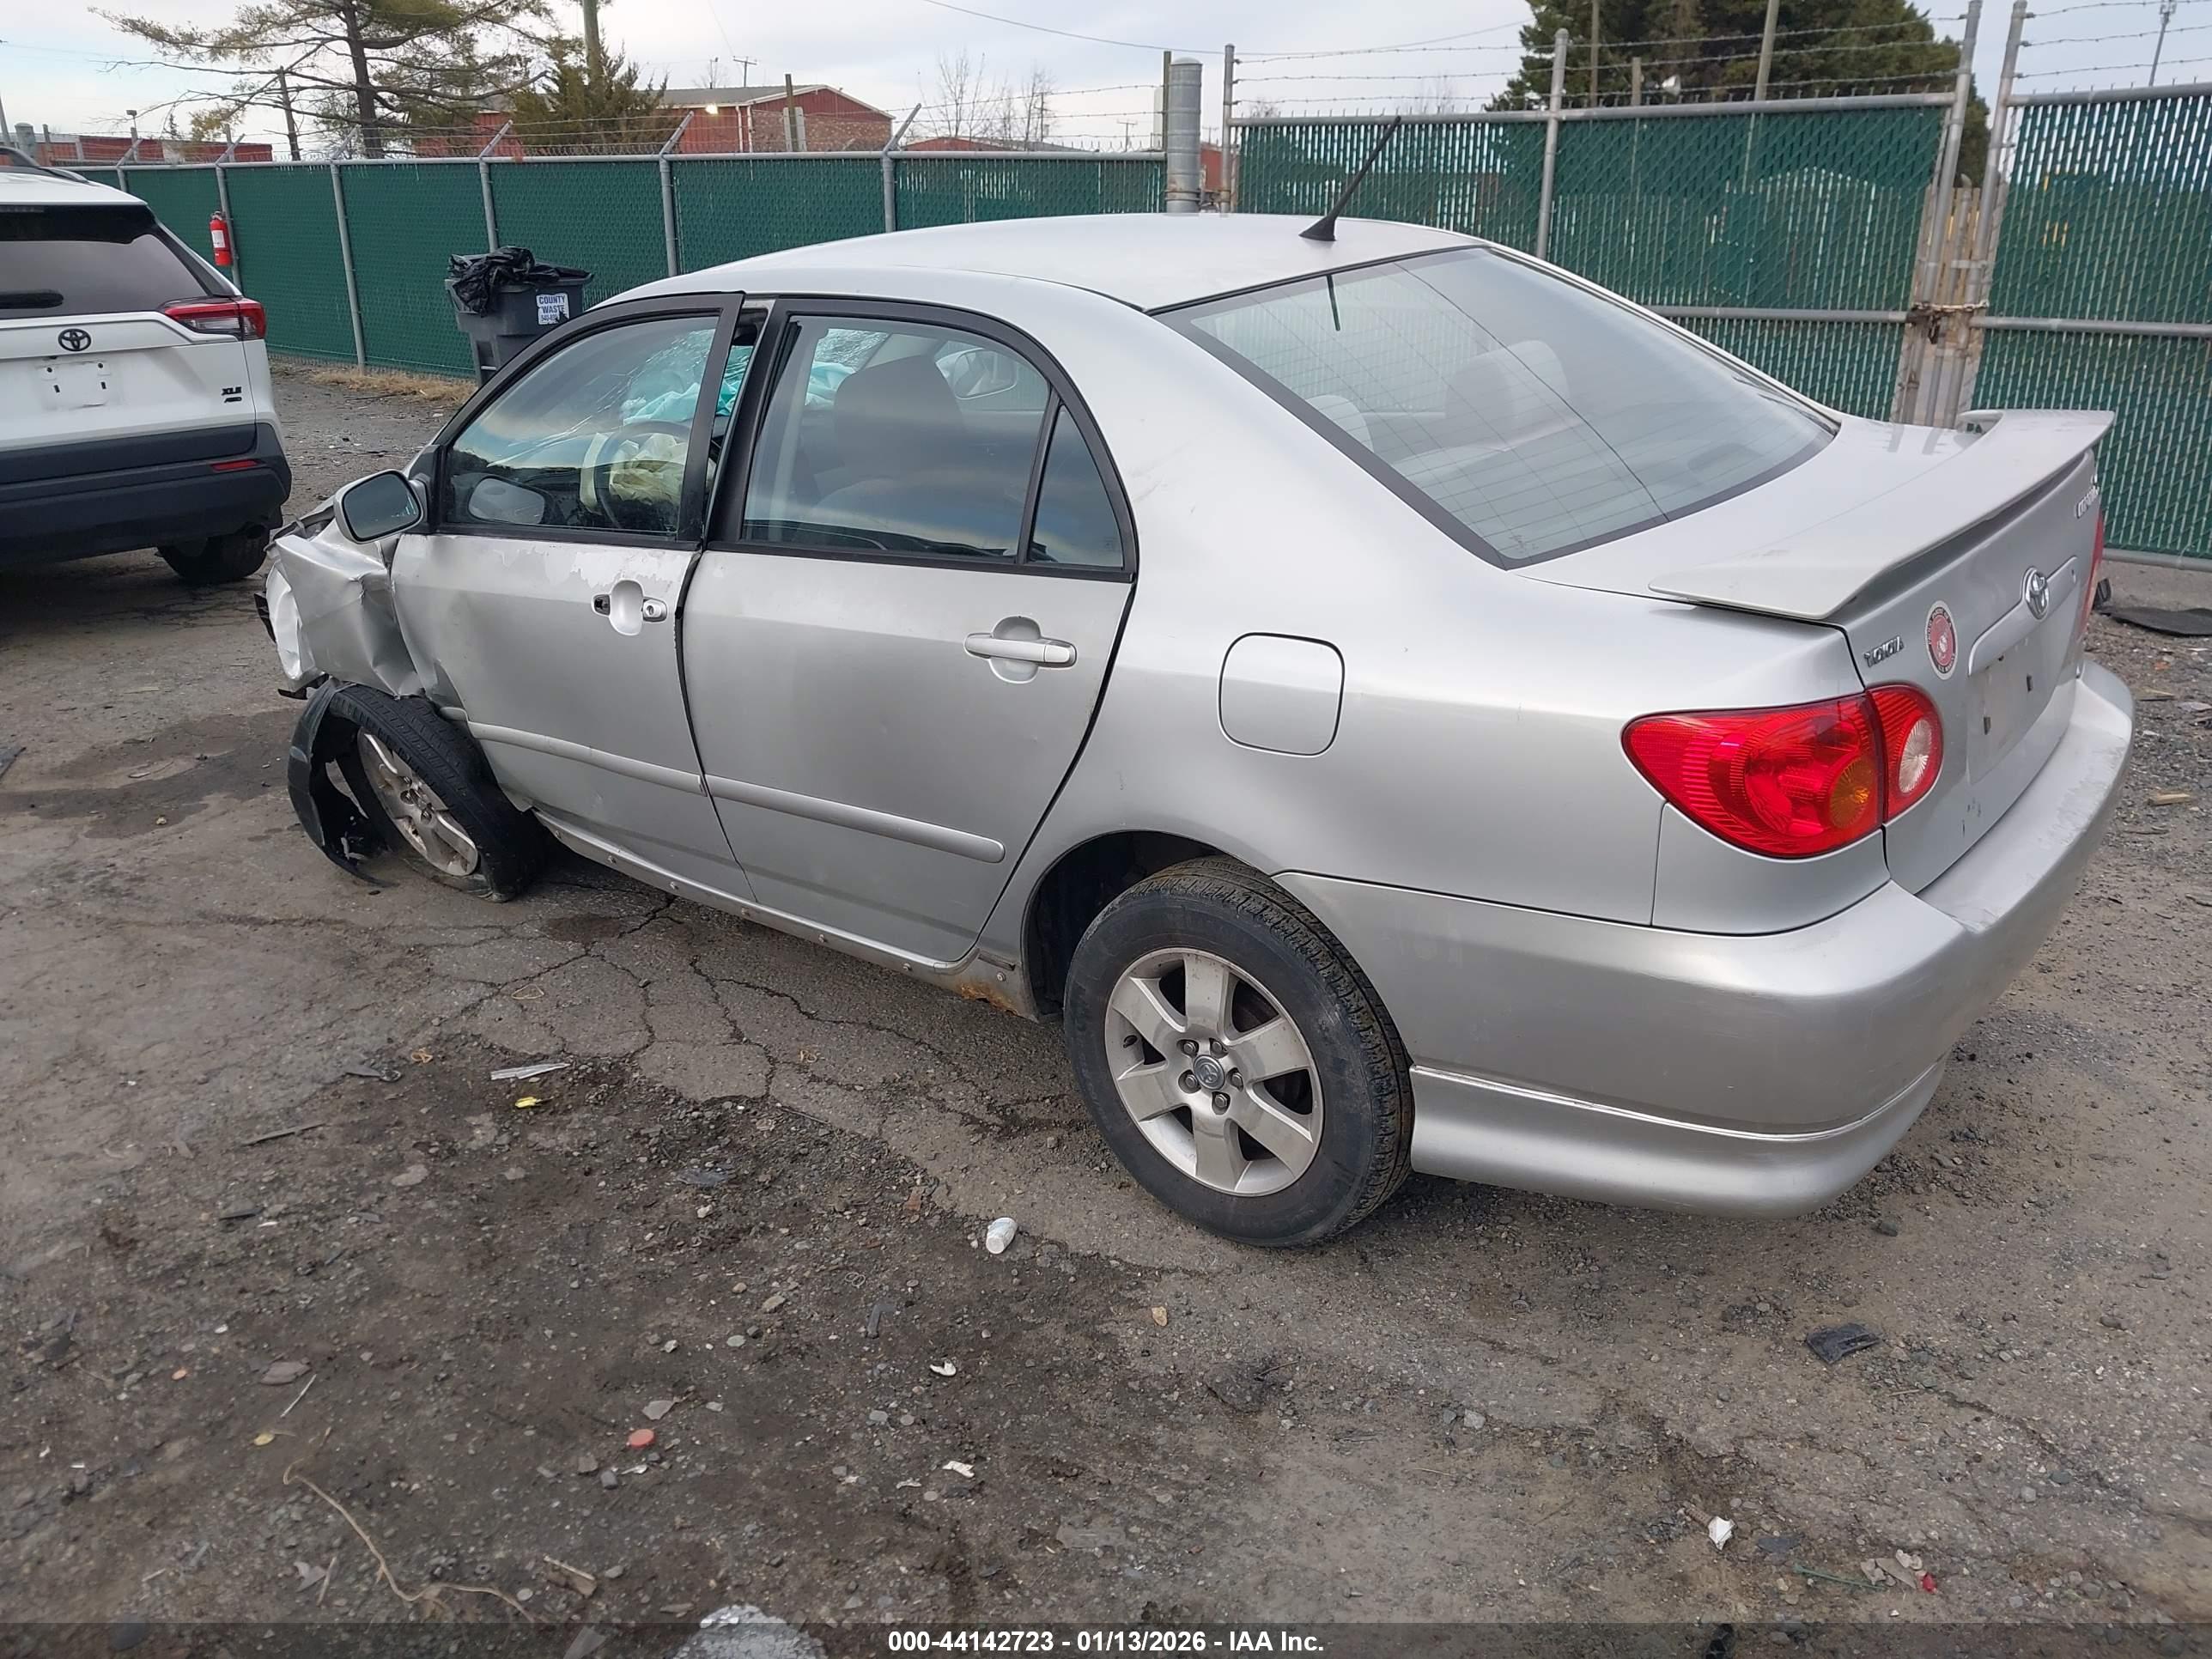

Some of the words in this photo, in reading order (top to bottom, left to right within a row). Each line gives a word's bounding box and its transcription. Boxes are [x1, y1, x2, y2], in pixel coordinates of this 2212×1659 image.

[538, 295, 565, 304] COUNTY
[542, 305, 564, 314] WASTE
[221, 386, 242, 396] XLE
